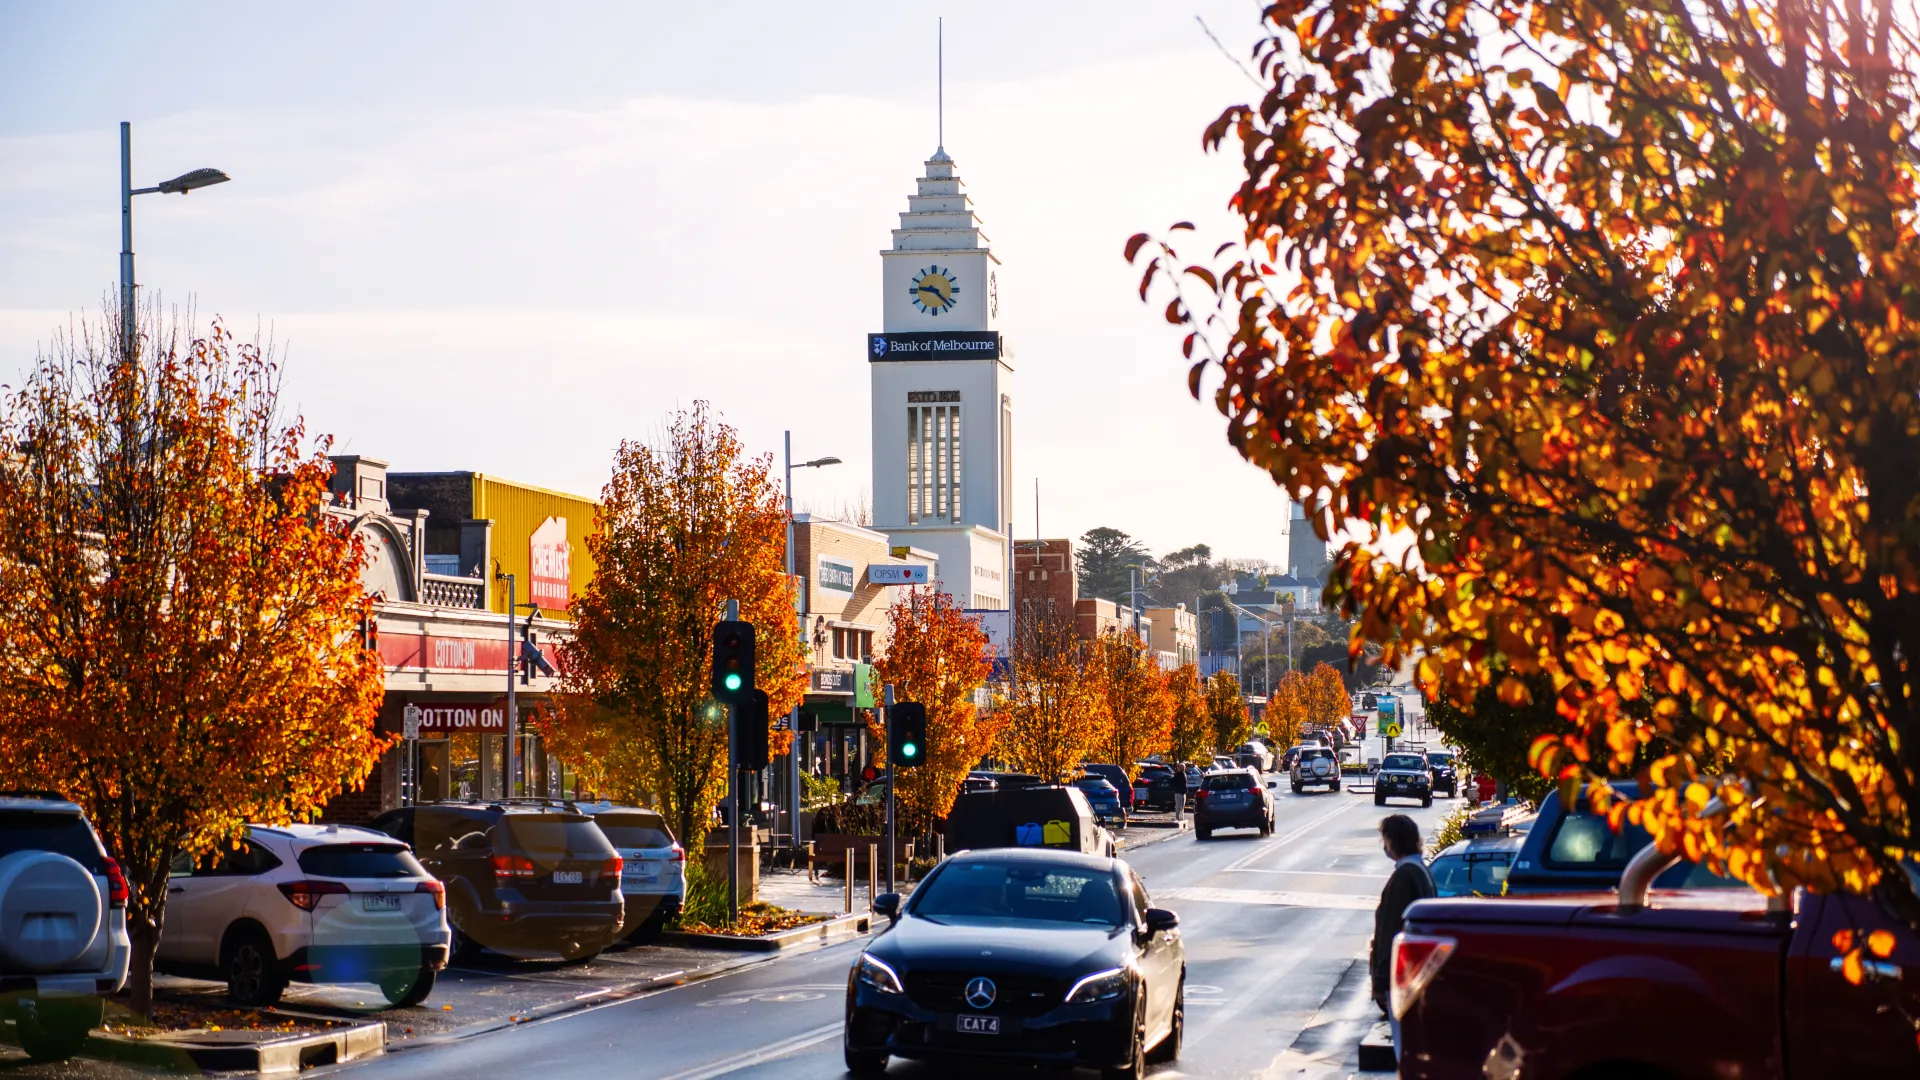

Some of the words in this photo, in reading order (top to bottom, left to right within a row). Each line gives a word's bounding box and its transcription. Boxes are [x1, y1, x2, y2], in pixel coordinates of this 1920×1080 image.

[891, 341, 919, 352] Bank
[920, 340, 932, 351] of
[933, 340, 994, 351] Melbourne
[533, 547, 568, 580] CHEMIST
[874, 569, 900, 579] OPSM
[533, 581, 568, 599] WAREHOUSE
[480, 708, 503, 728] ON
[964, 1018, 988, 1031] CAT
[989, 1020, 997, 1031] 4
